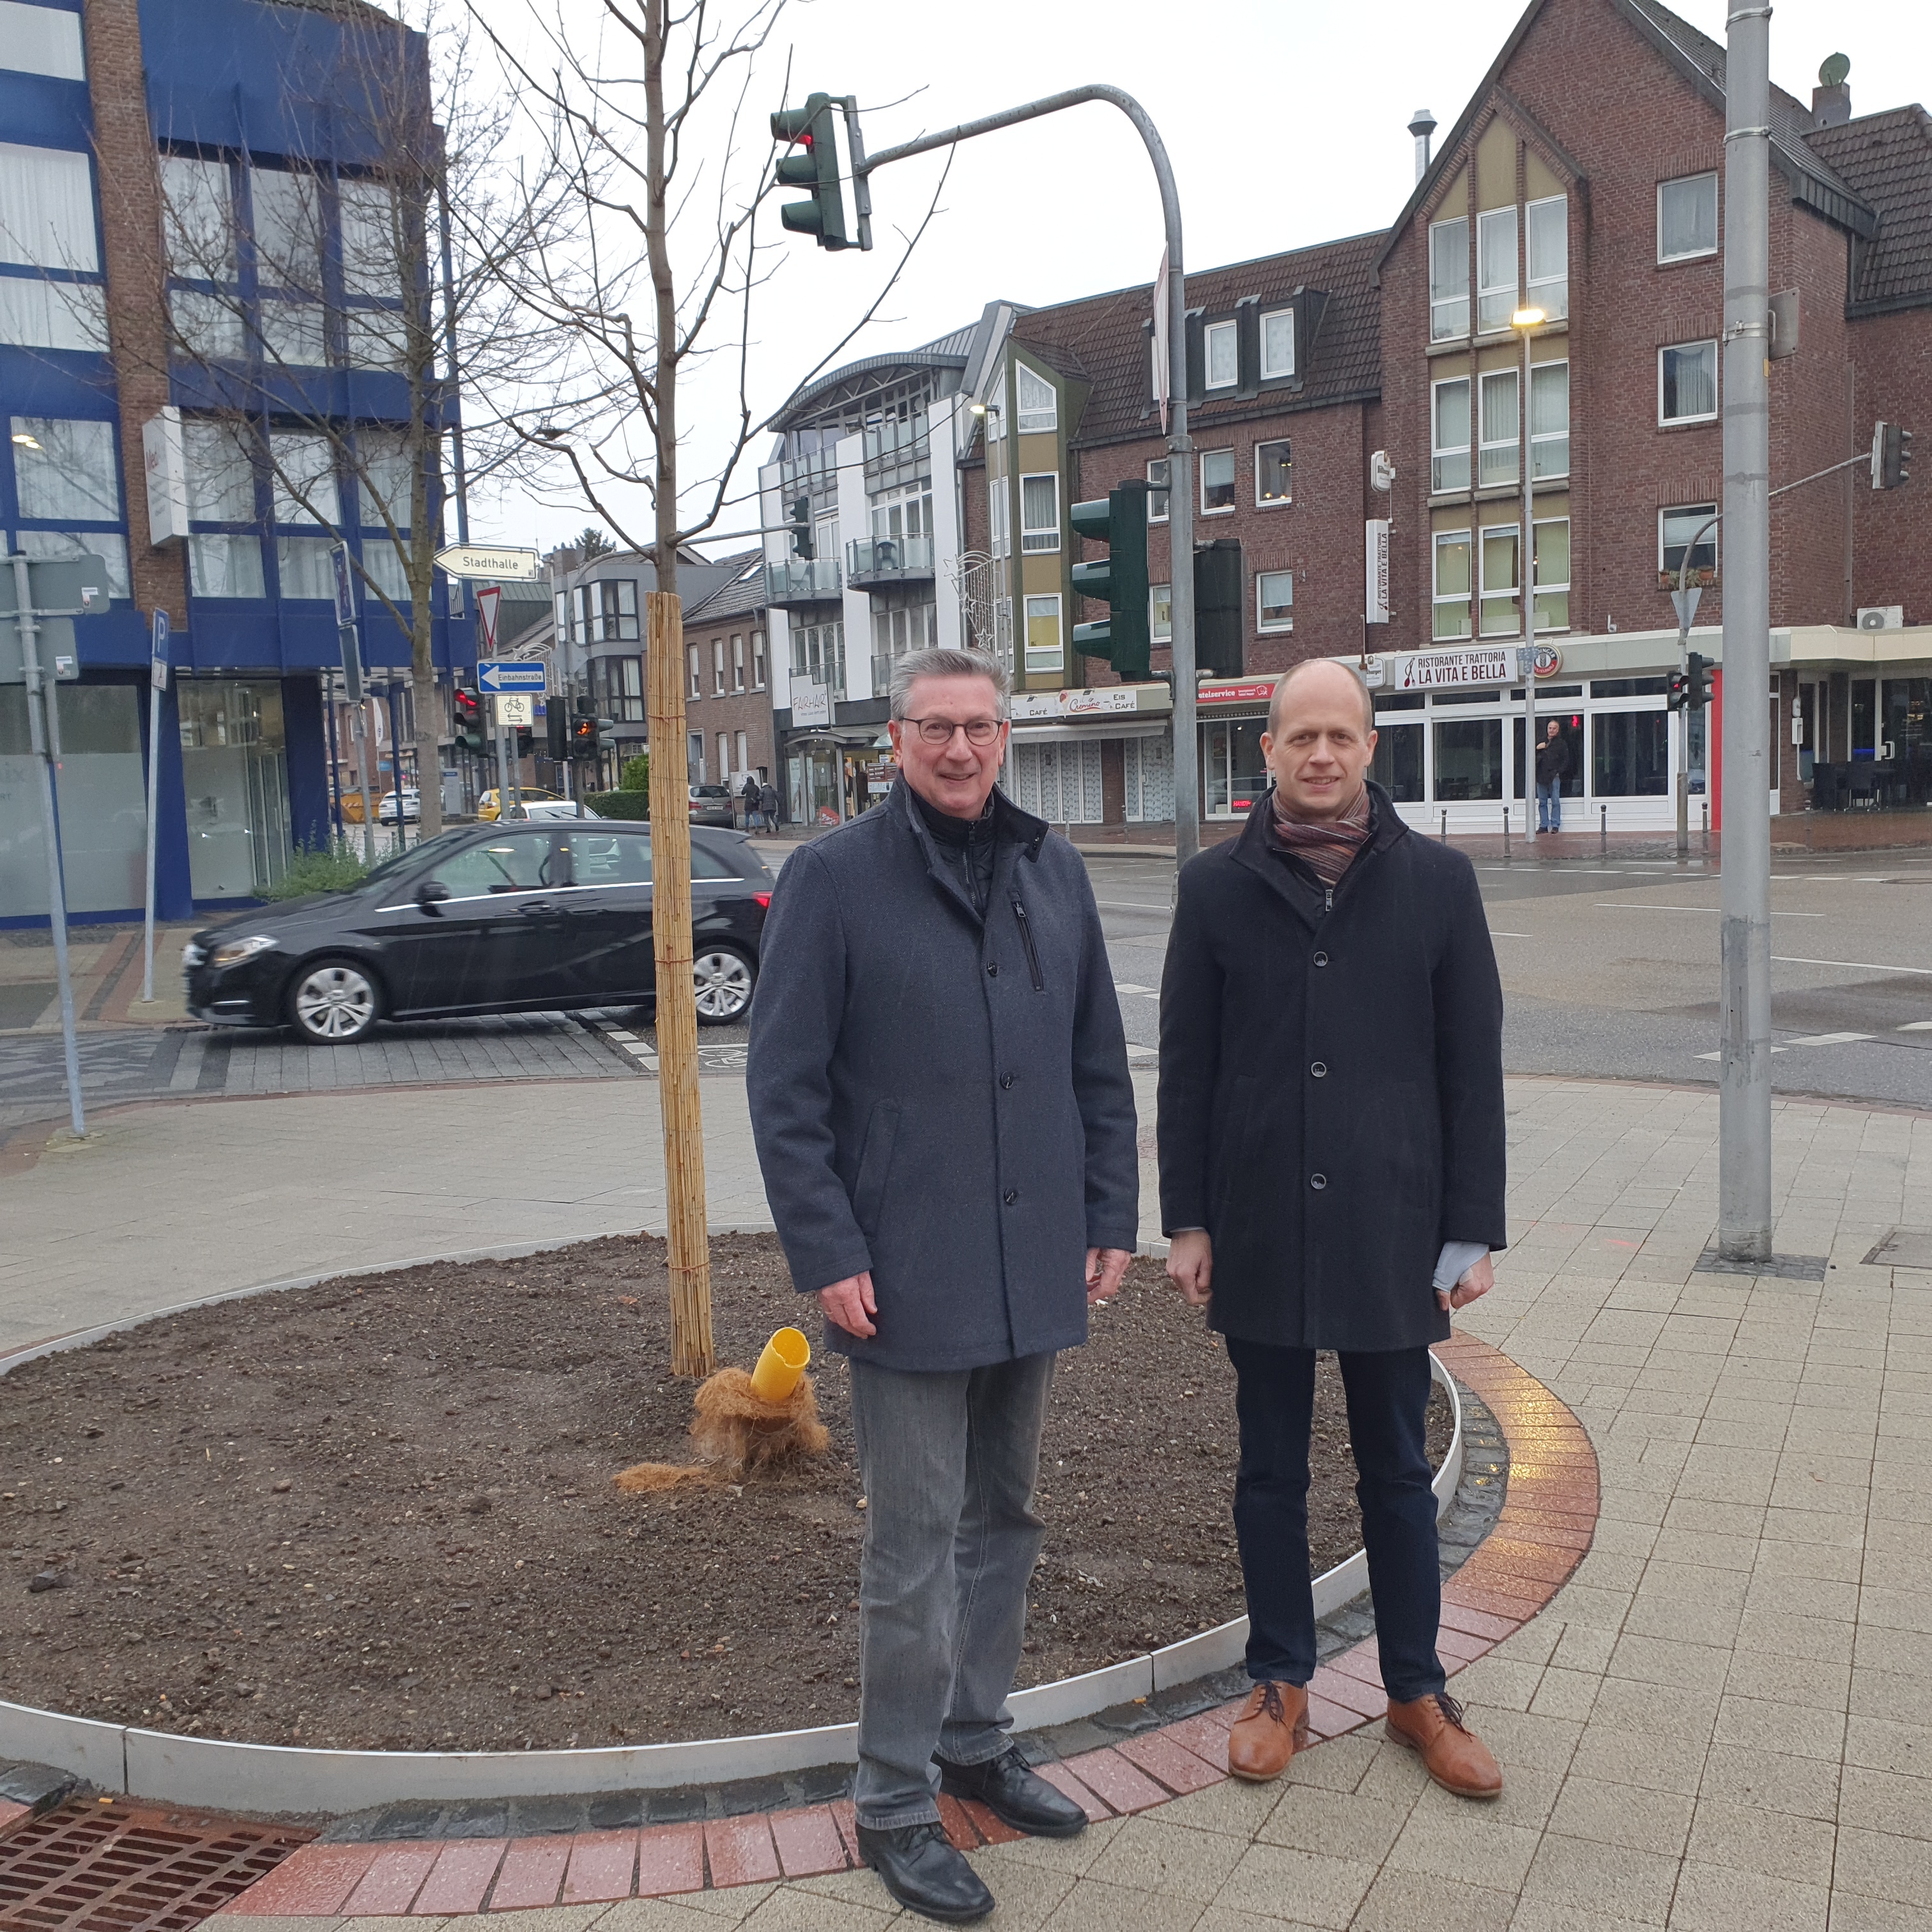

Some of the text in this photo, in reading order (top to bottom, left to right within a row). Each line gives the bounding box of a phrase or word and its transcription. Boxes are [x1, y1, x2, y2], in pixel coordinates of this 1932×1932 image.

[463, 556, 519, 569] Stadthalle
[1381, 589, 1387, 599] LA
[1418, 651, 1506, 668] RISTORANTE TRATTORIA
[1418, 663, 1506, 685] LA VITA E BELLA
[1115, 700, 1135, 709] CAFÉ
[1029, 707, 1048, 716] CAFÉ
